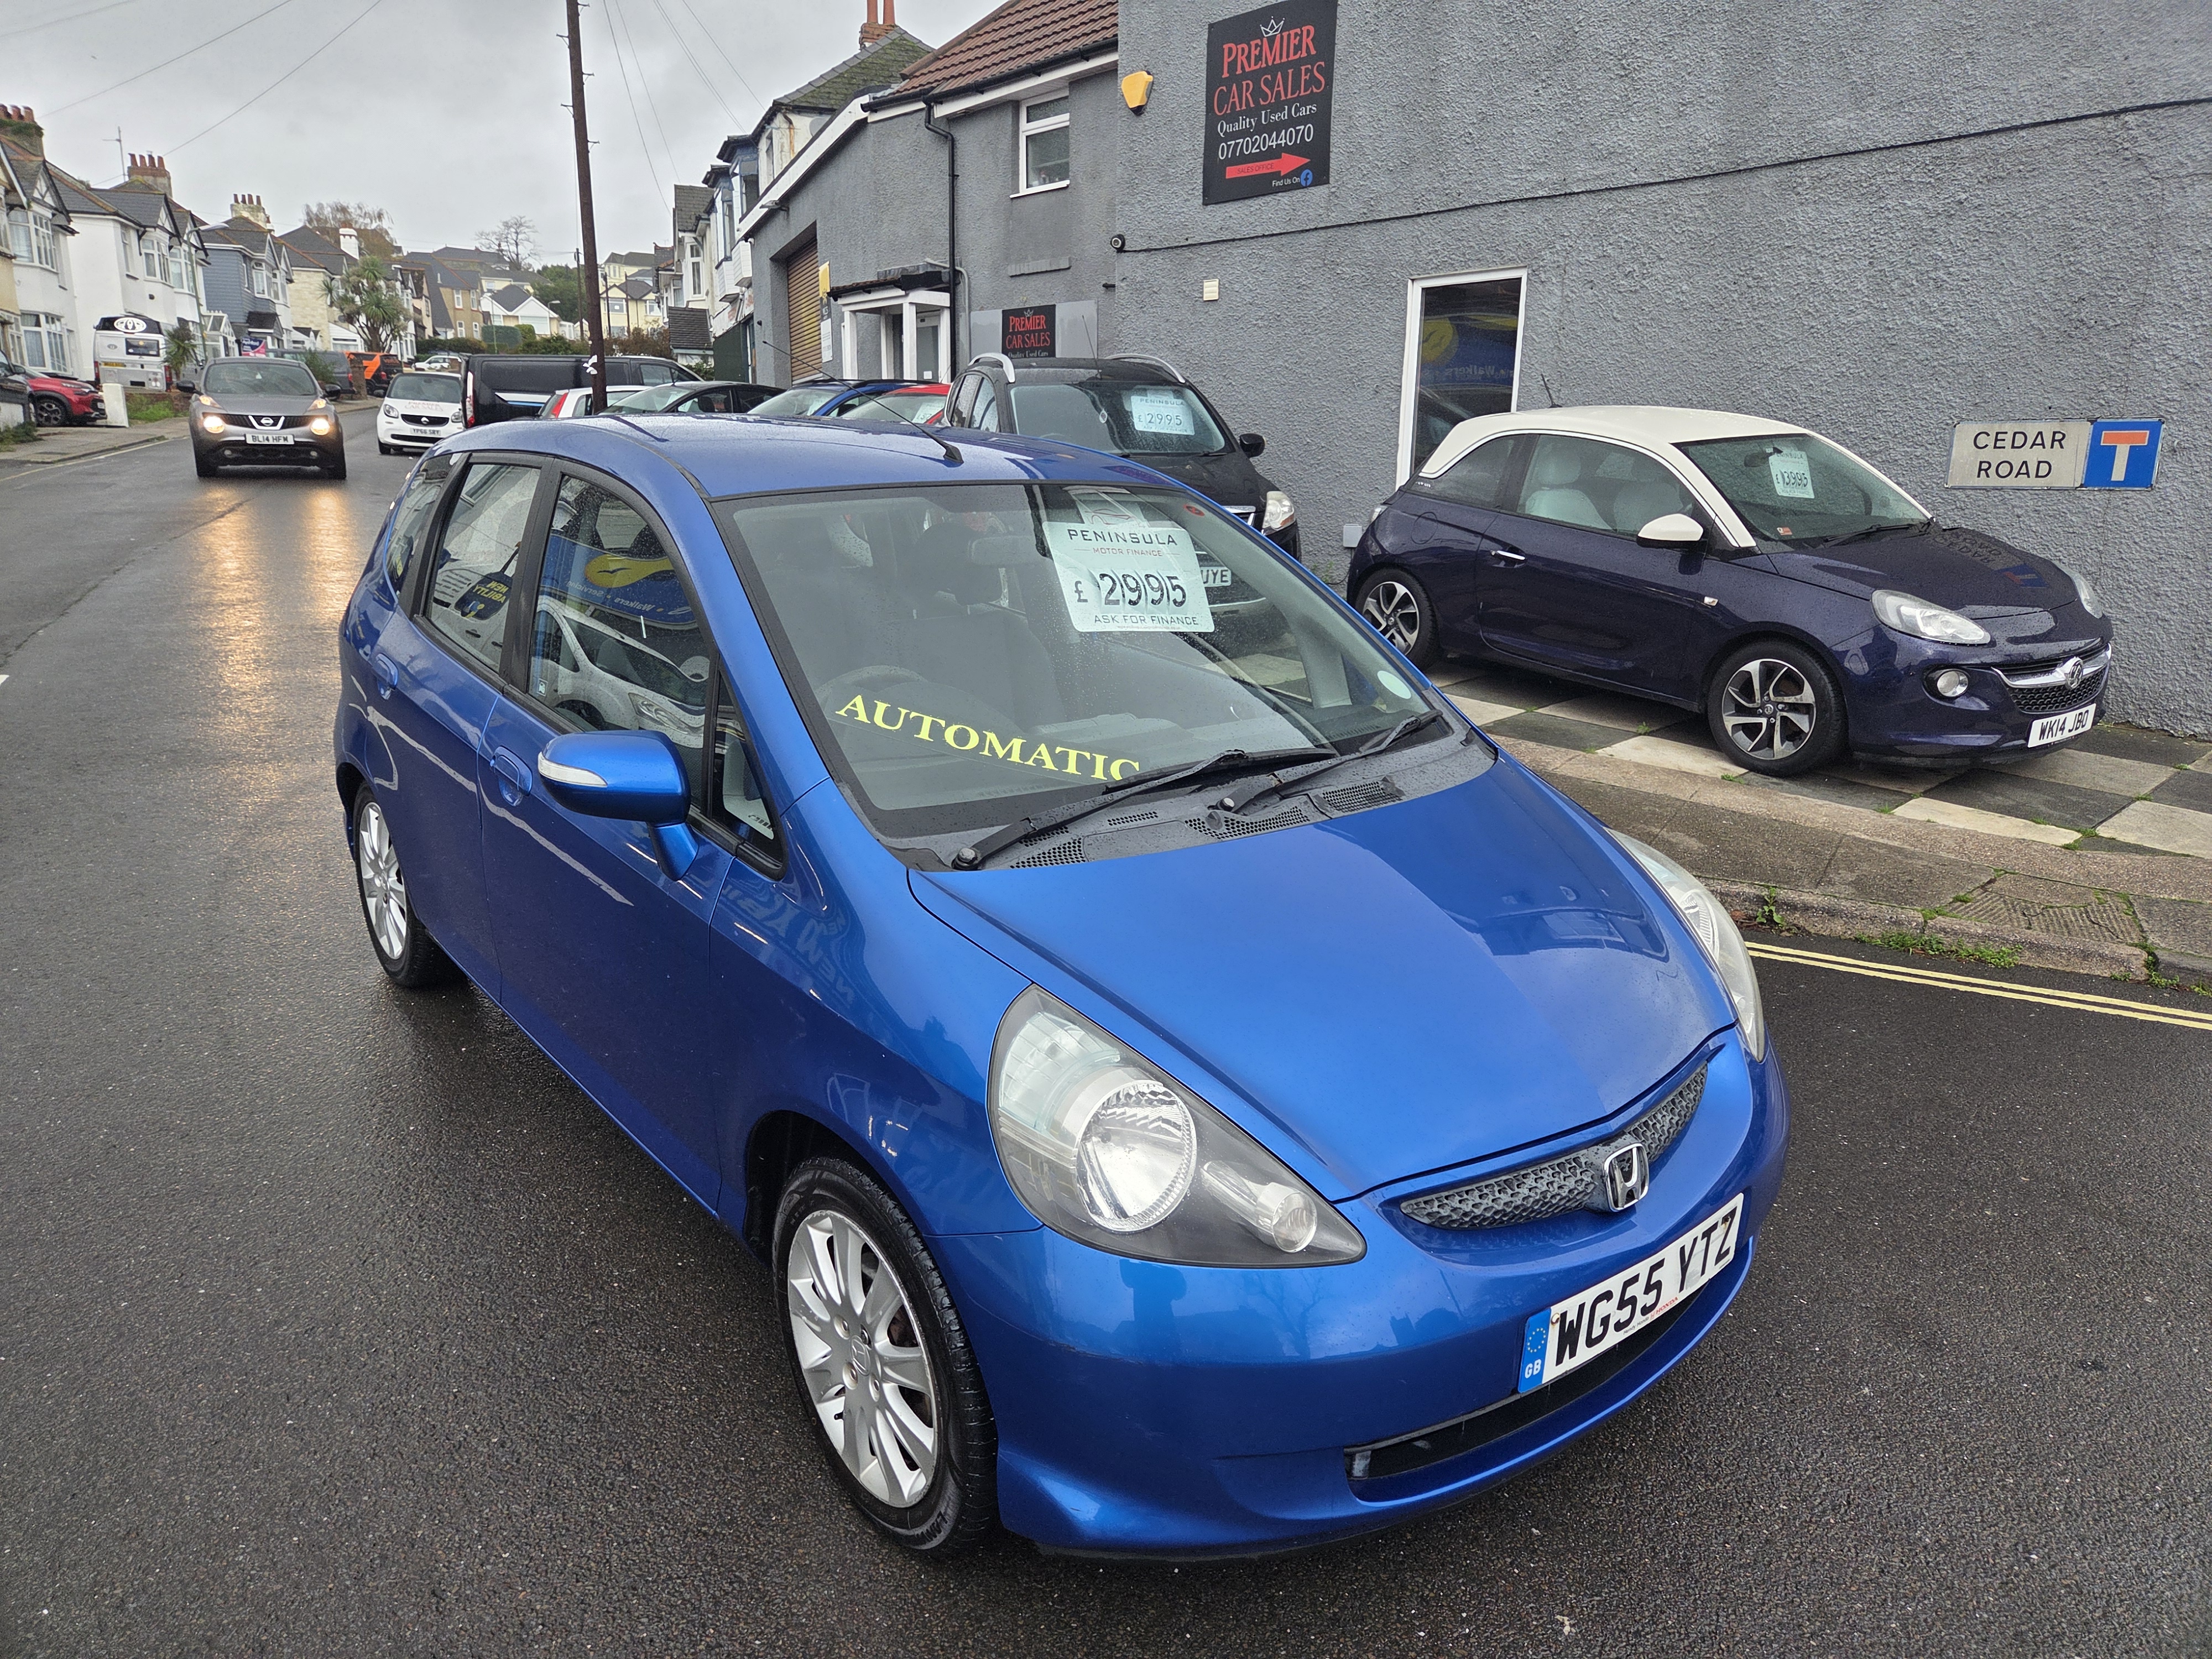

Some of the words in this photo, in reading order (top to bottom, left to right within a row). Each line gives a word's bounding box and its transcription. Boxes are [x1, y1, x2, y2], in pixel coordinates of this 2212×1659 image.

[1222, 25, 1316, 77] PREMIER
[1214, 80, 1255, 115] CAR
[1259, 61, 1325, 105] SALES
[1217, 116, 1257, 137] Quality
[1261, 106, 1287, 125] Used
[1291, 103, 1317, 118] Cars
[1218, 123, 1314, 159] 07702044070
[1237, 165, 1254, 174] SALES
[1255, 163, 1274, 172] OFFICE
[1009, 315, 1046, 332] PREMIER
[1006, 335, 1023, 349] CAR
[1025, 332, 1050, 347] SALES
[1147, 413, 1182, 426] 2995
[1973, 430, 2066, 450] CEDAR
[1783, 471, 1808, 487] 3995
[1977, 460, 2052, 479] ROAD
[1067, 529, 1177, 546] PENINSULA
[1074, 581, 1088, 603] £
[1099, 573, 1186, 607] 2995
[1094, 615, 1119, 624] ASK
[1123, 615, 1147, 625] FOR
[1150, 616, 1199, 625] FINANCE
[2038, 717, 2067, 740] WK14
[2068, 709, 2089, 733] JBO
[835, 694, 1140, 781] AUTOMATIC
[1555, 1257, 1665, 1367] WG55
[1679, 1206, 1738, 1293] YTZ
[1656, 1297, 1678, 1314] HONDA
[1525, 1359, 1542, 1379] GB
